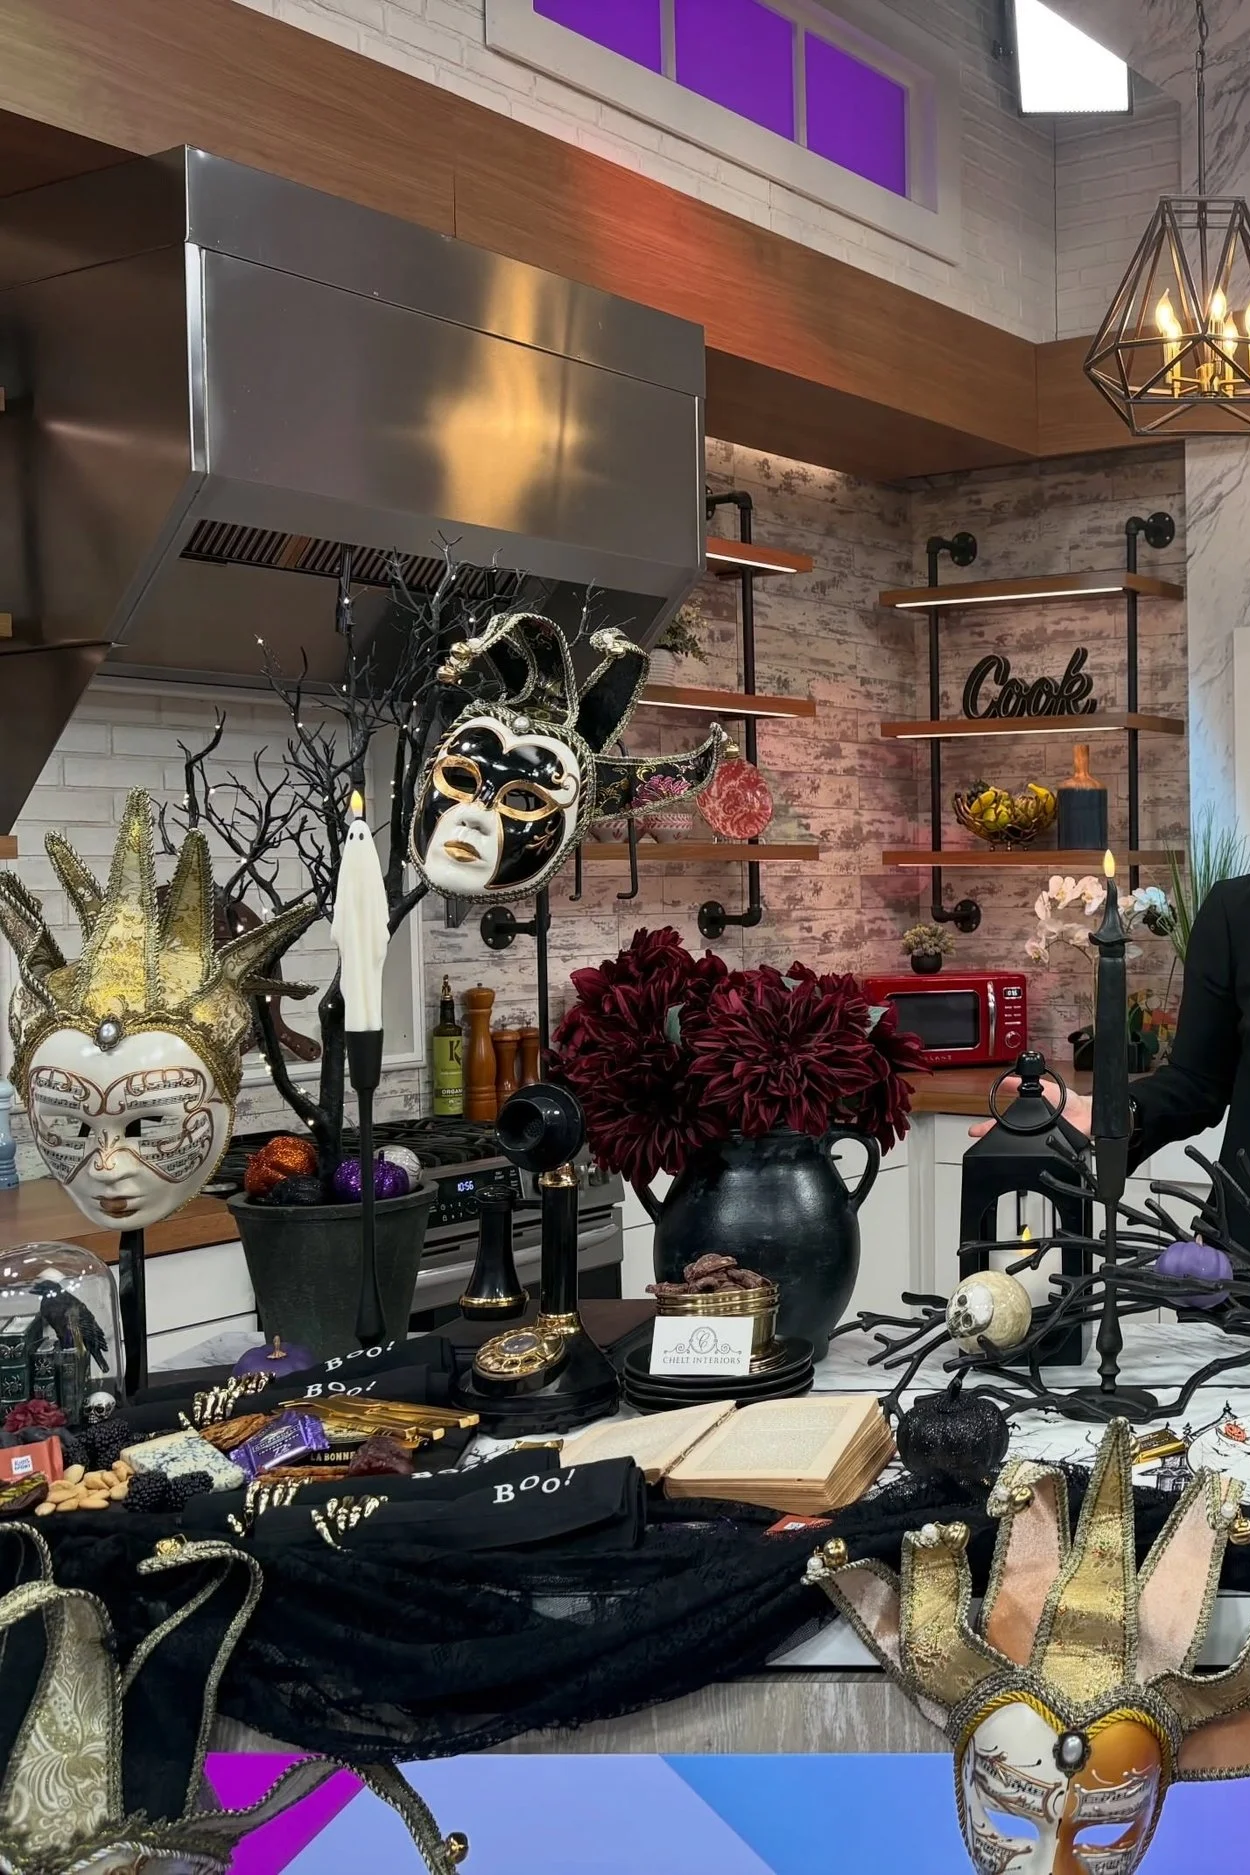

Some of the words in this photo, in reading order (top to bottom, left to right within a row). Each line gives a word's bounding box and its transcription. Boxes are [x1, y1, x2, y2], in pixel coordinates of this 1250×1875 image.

[963, 647, 1097, 719] Cook
[457, 1181, 474, 1192] 10:56
[692, 1356, 741, 1365] INTERIORS
[310, 1452, 322, 1461] LA
[492, 1468, 576, 1504] BOO!
